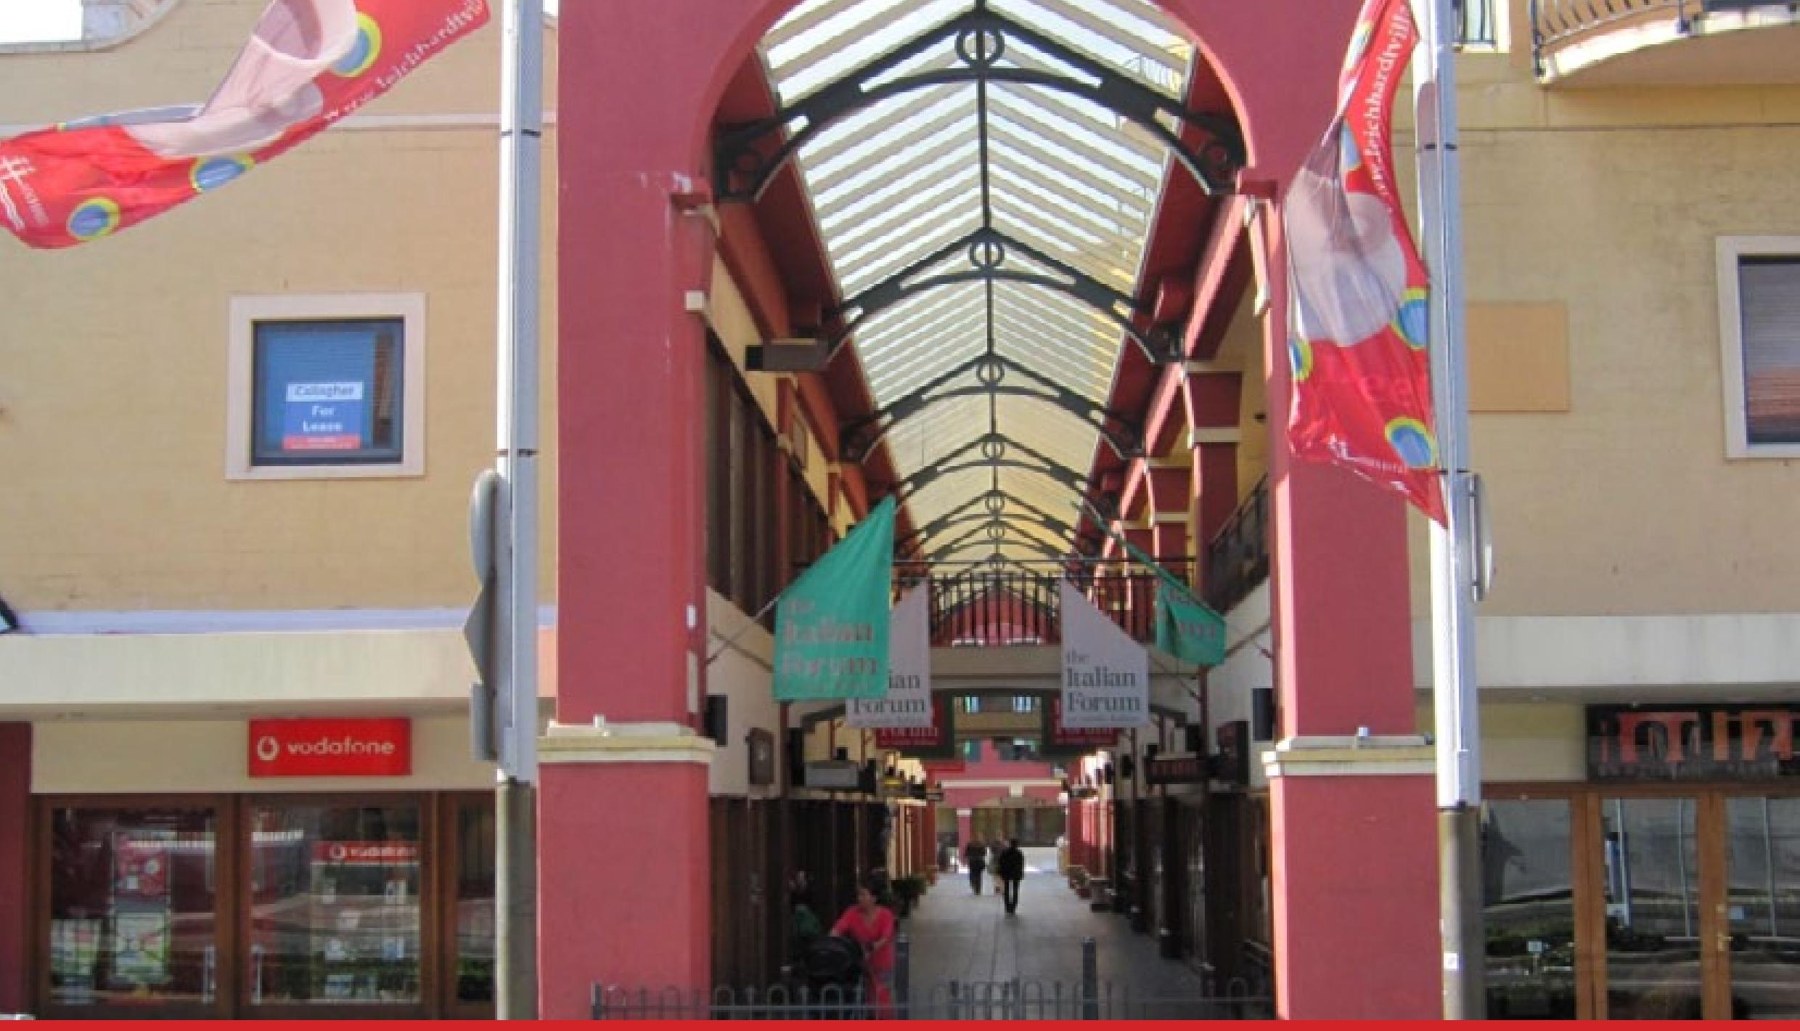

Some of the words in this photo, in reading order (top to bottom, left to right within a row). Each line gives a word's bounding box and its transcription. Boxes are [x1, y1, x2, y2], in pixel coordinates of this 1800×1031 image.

[784, 617, 873, 644] Italian
[781, 652, 878, 677] Forum
[1066, 648, 1091, 665] the
[1067, 666, 1136, 686] Italian
[853, 696, 927, 714] Forum
[1067, 691, 1141, 712] Forum
[287, 735, 396, 756] vodafone
